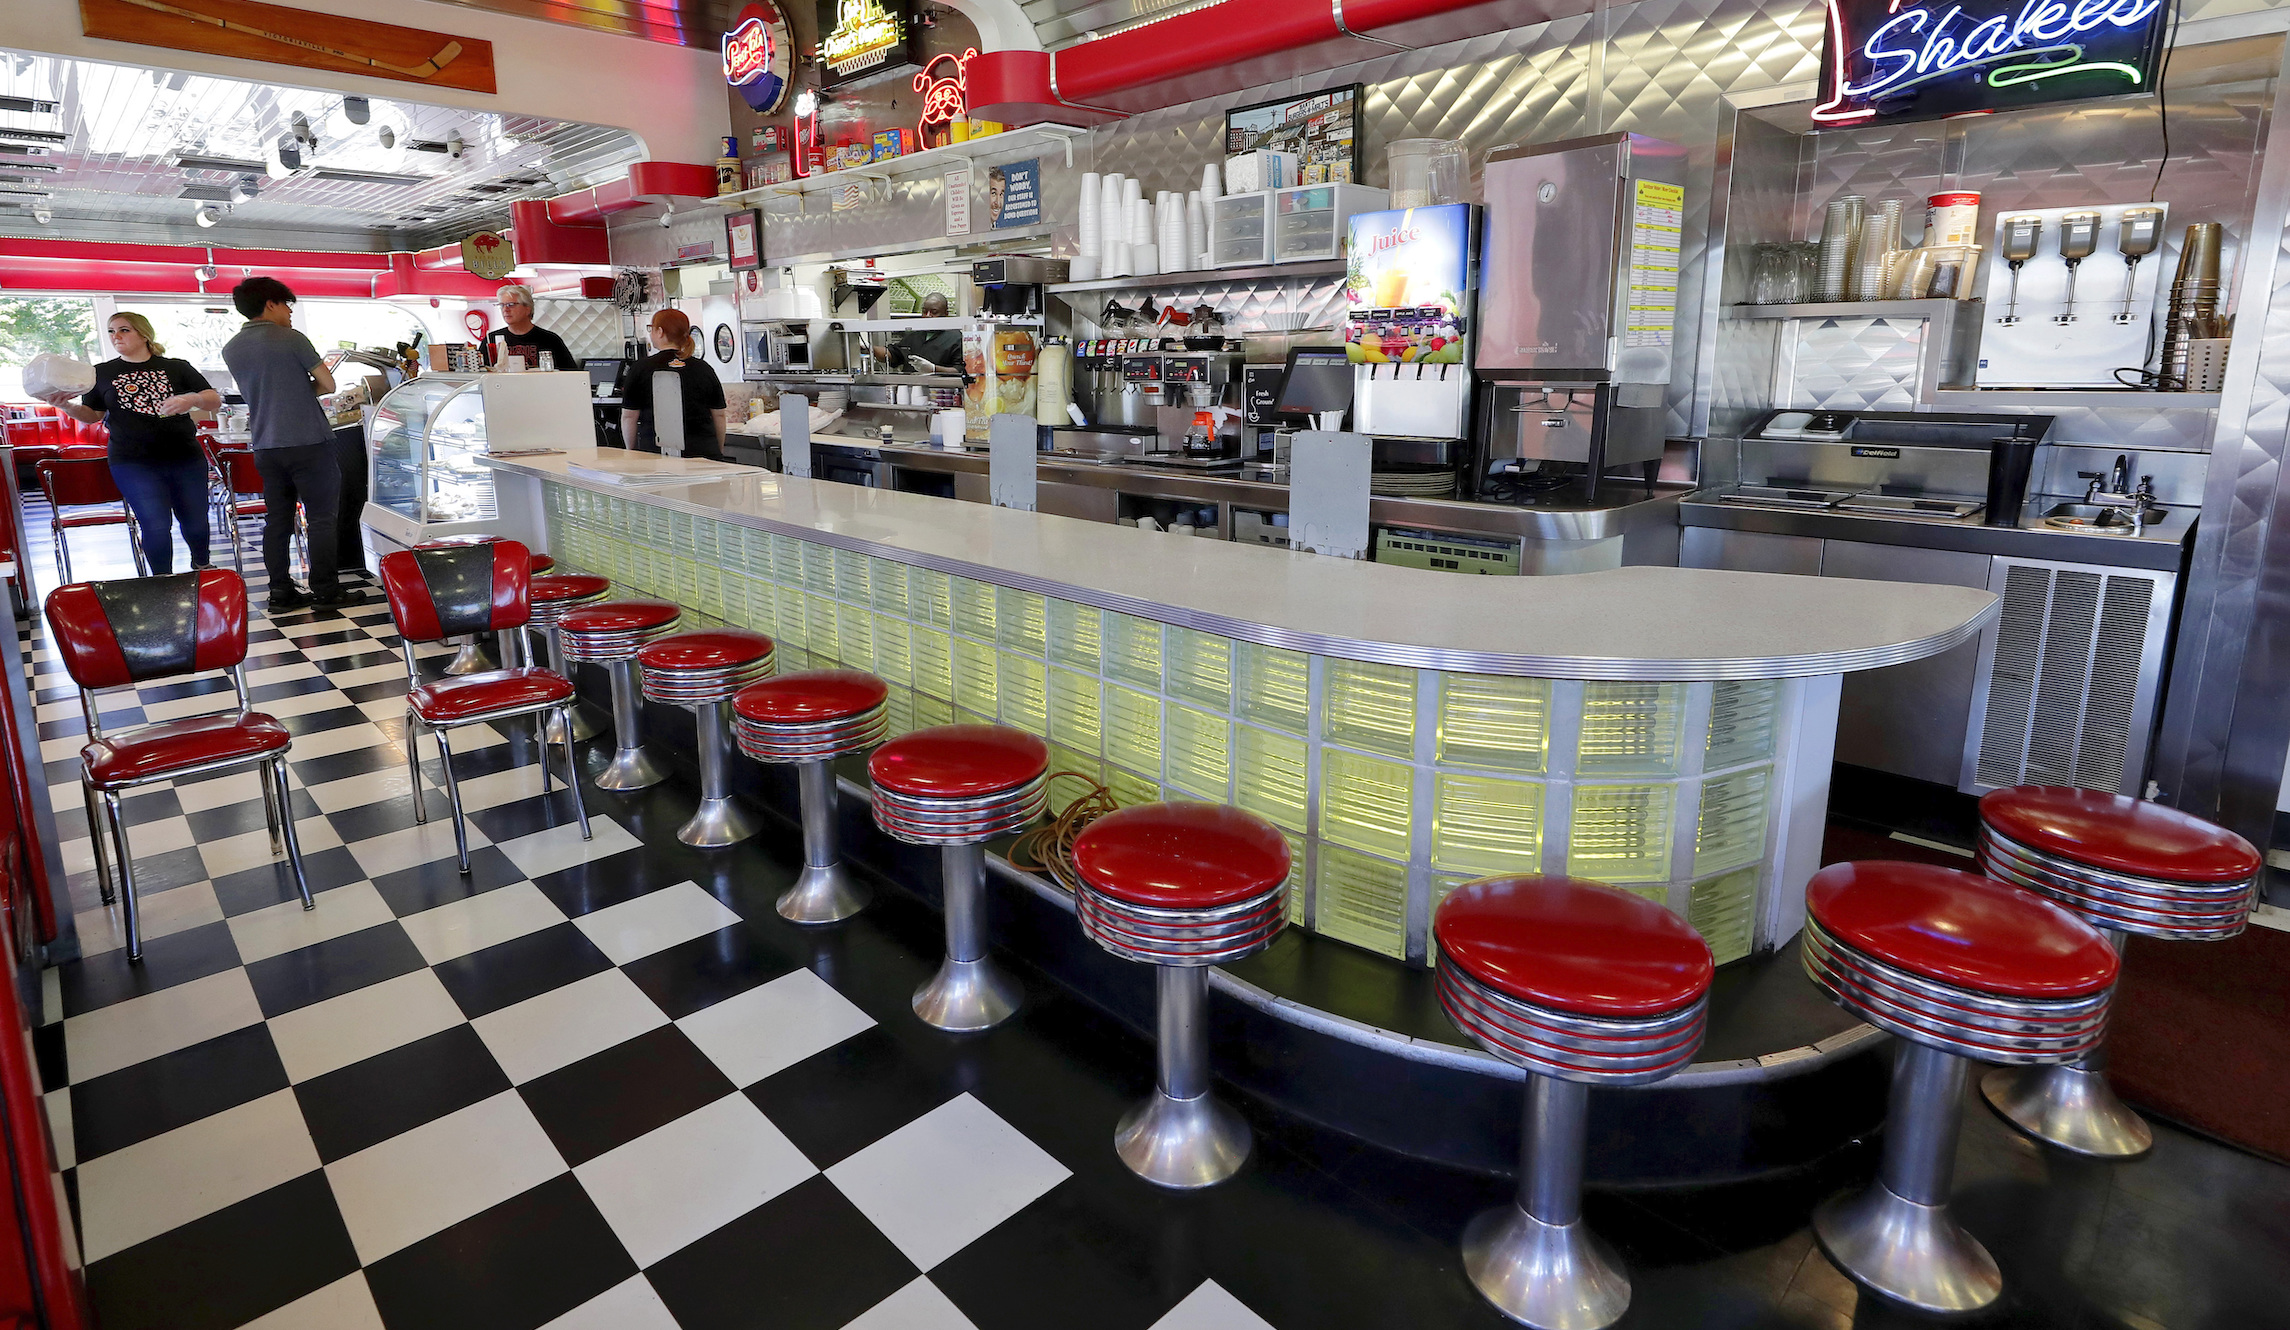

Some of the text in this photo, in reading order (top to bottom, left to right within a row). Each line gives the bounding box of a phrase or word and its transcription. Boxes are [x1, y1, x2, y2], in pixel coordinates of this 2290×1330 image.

[264, 31, 325, 51] VICTORIAVILLE
[1843, 0, 2160, 96] Shakes
[1011, 171, 1029, 182] DON'T
[1007, 194, 1017, 202] OUR
[1016, 192, 1028, 200] STAFF
[1030, 199, 1037, 207] TO
[1368, 226, 1420, 257] Juice
[472, 260, 506, 270] BILLS
[1007, 353, 1026, 361] Quench
